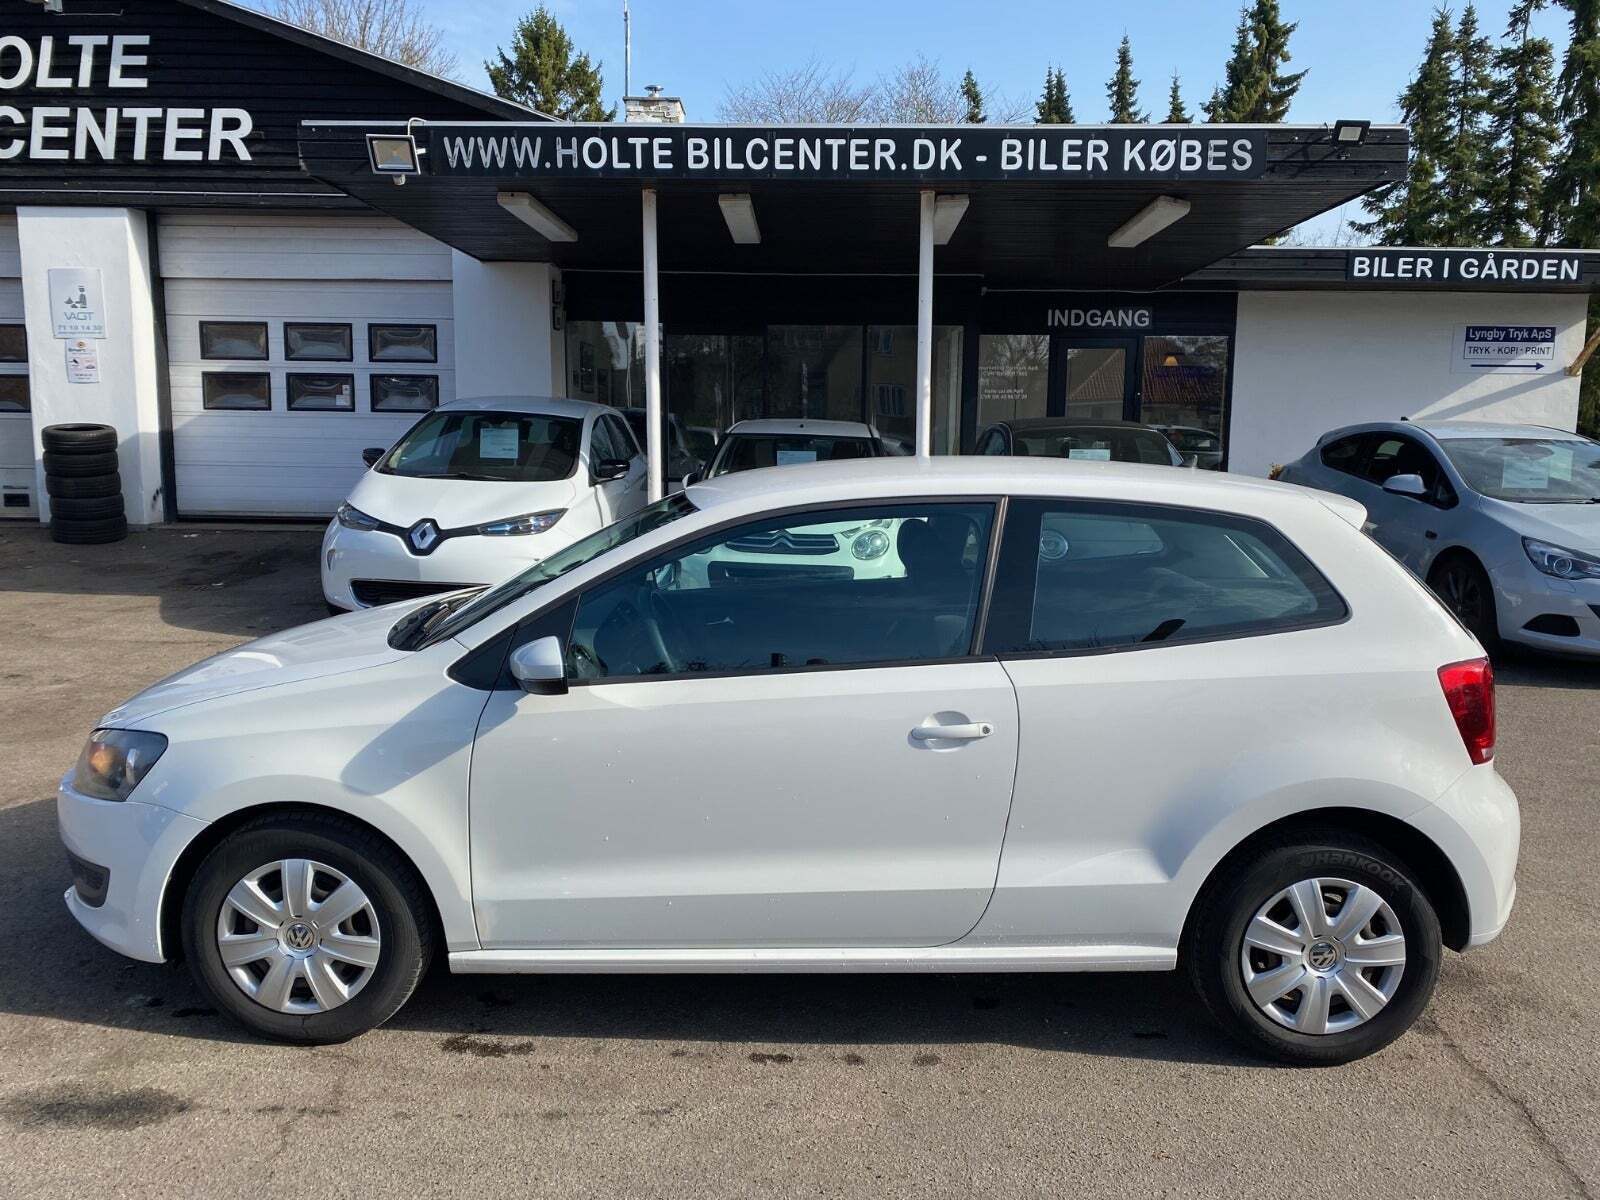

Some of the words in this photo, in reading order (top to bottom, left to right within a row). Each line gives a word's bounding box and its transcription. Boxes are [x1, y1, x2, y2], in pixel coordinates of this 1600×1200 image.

[0, 35, 151, 89] OLTE
[443, 136, 673, 170] WWW.HOLTE
[687, 137, 963, 172] BILCENTER.DK
[1001, 138, 1109, 172] BILER
[1123, 138, 1253, 173] KØBES
[1353, 256, 1433, 279] BILER
[1443, 257, 1450, 279] I
[1459, 253, 1579, 281] GÅRDEN
[64, 311, 94, 321] VAGT
[1047, 308, 1150, 327] INDGANG
[1469, 328, 1506, 341] Lyngby
[1508, 328, 1529, 341] Tryk
[1531, 328, 1552, 341] ApS
[1468, 346, 1491, 355] TRYK
[1497, 346, 1518, 355] KOPI
[1525, 346, 1551, 355] PRINT
